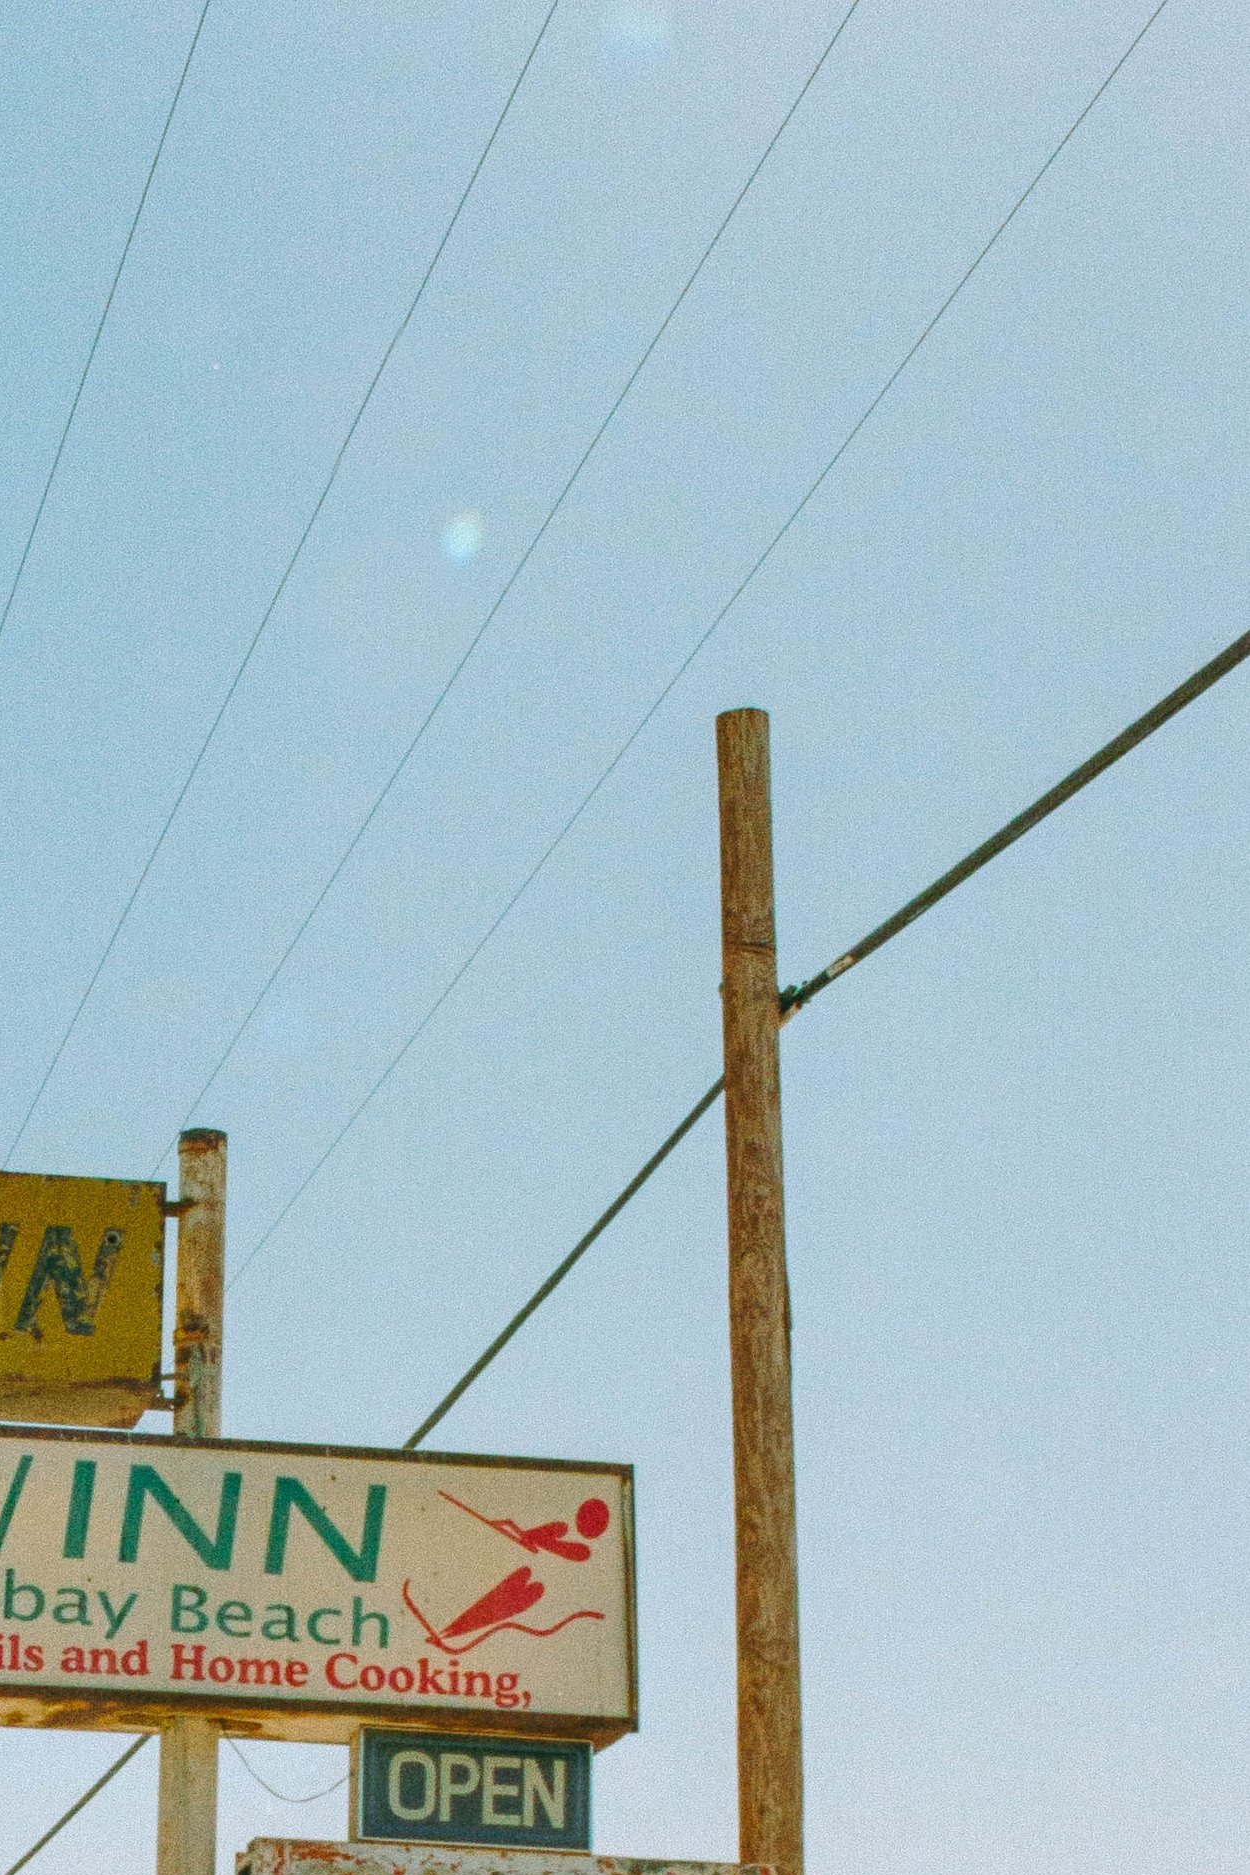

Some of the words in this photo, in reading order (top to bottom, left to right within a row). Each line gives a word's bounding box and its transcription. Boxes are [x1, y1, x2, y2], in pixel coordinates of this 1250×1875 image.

[63, 1459, 387, 1583] INN
[169, 1582, 391, 1650] Beach
[60, 1640, 150, 1678] and
[169, 1643, 310, 1688] Home
[323, 1650, 533, 1709] Cooking,
[387, 1749, 567, 1830] OPEN
